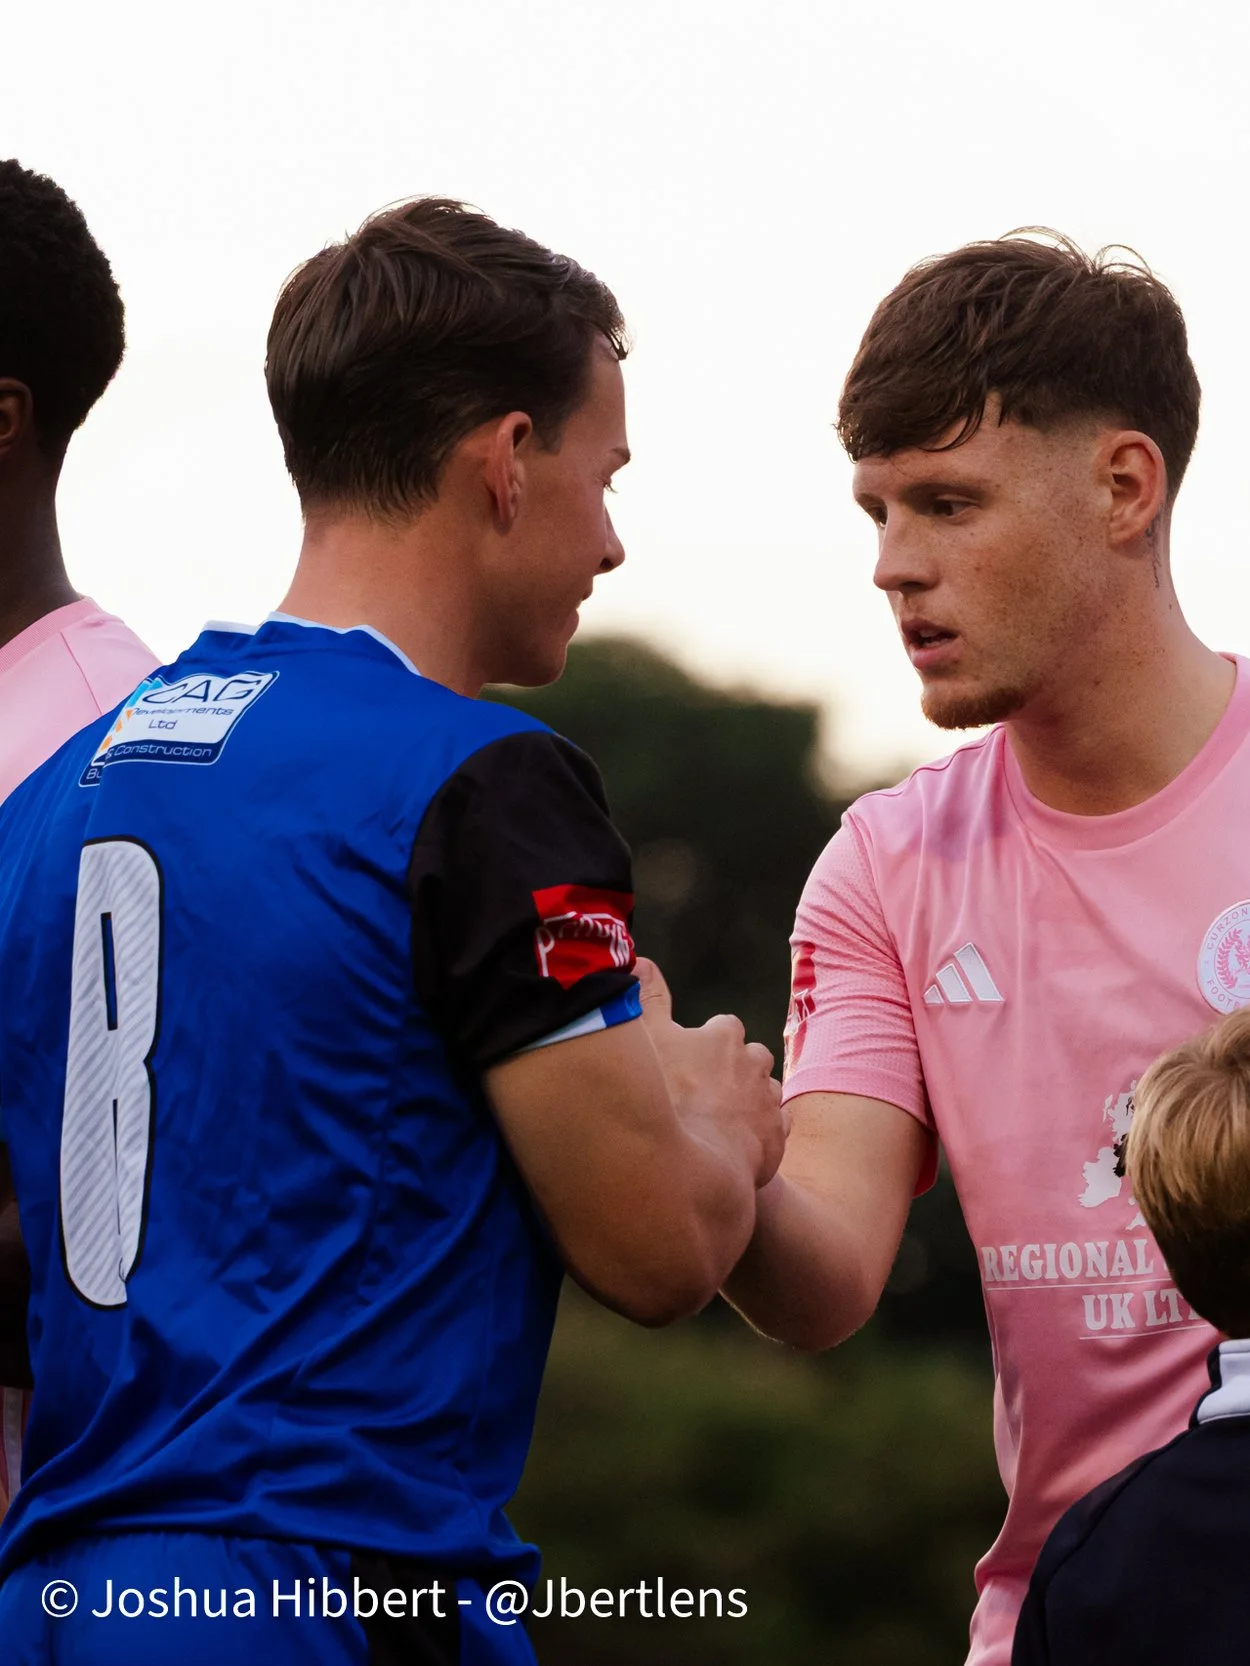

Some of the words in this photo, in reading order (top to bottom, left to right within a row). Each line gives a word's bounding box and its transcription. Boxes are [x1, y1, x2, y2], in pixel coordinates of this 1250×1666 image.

[142, 679, 260, 703] CAG
[148, 720, 178, 730] Ltd
[114, 744, 212, 757] Construction
[1206, 906, 1249, 950] CURZON
[1207, 979, 1241, 1009] FOOTB
[981, 1239, 1155, 1282] REGIONAL
[1082, 1293, 1136, 1330] UK
[1143, 1287, 1203, 1326] LT
